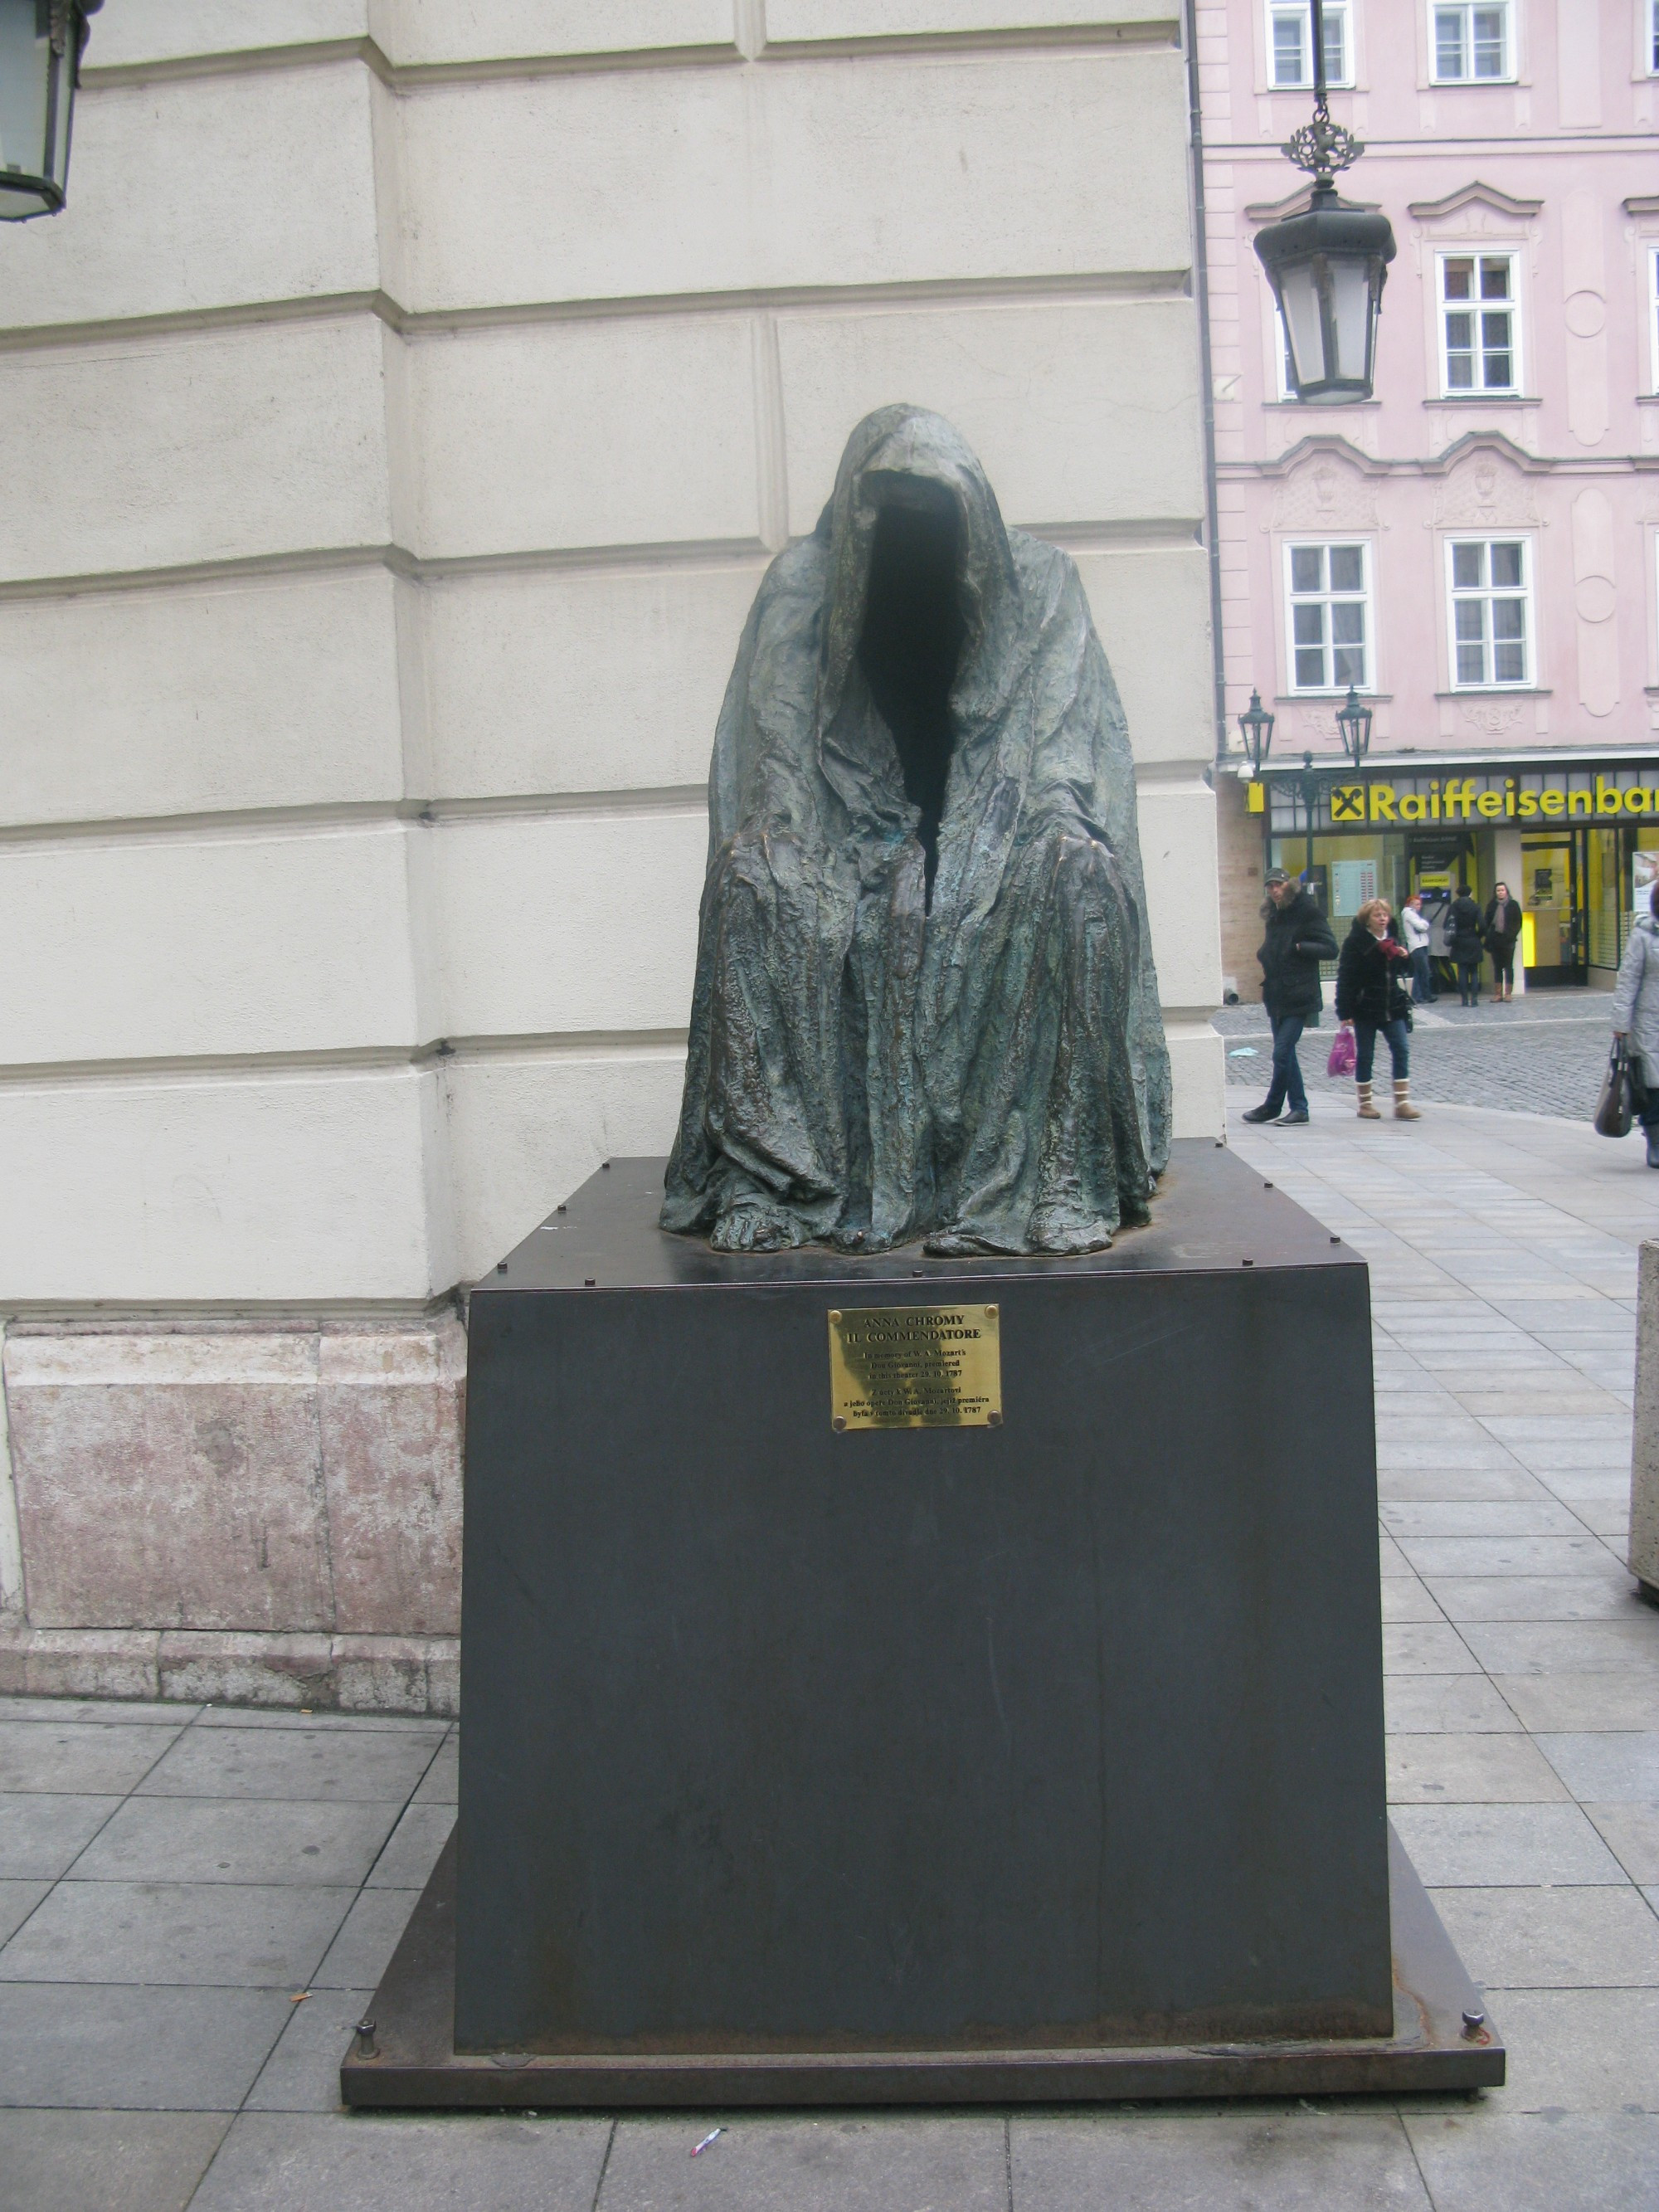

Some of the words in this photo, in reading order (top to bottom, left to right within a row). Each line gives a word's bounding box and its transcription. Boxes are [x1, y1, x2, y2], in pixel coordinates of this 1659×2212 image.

[864, 1317, 899, 1328] ANNA
[906, 1315, 965, 1327] CHROMY
[847, 1333, 862, 1343] IL
[866, 1328, 981, 1342] COMMENDATORE
[925, 1359, 960, 1369] premiered
[946, 1369, 962, 1377] 1787
[849, 1400, 864, 1408] jeho
[853, 1410, 868, 1418] byla
[964, 1406, 981, 1414] 1787
